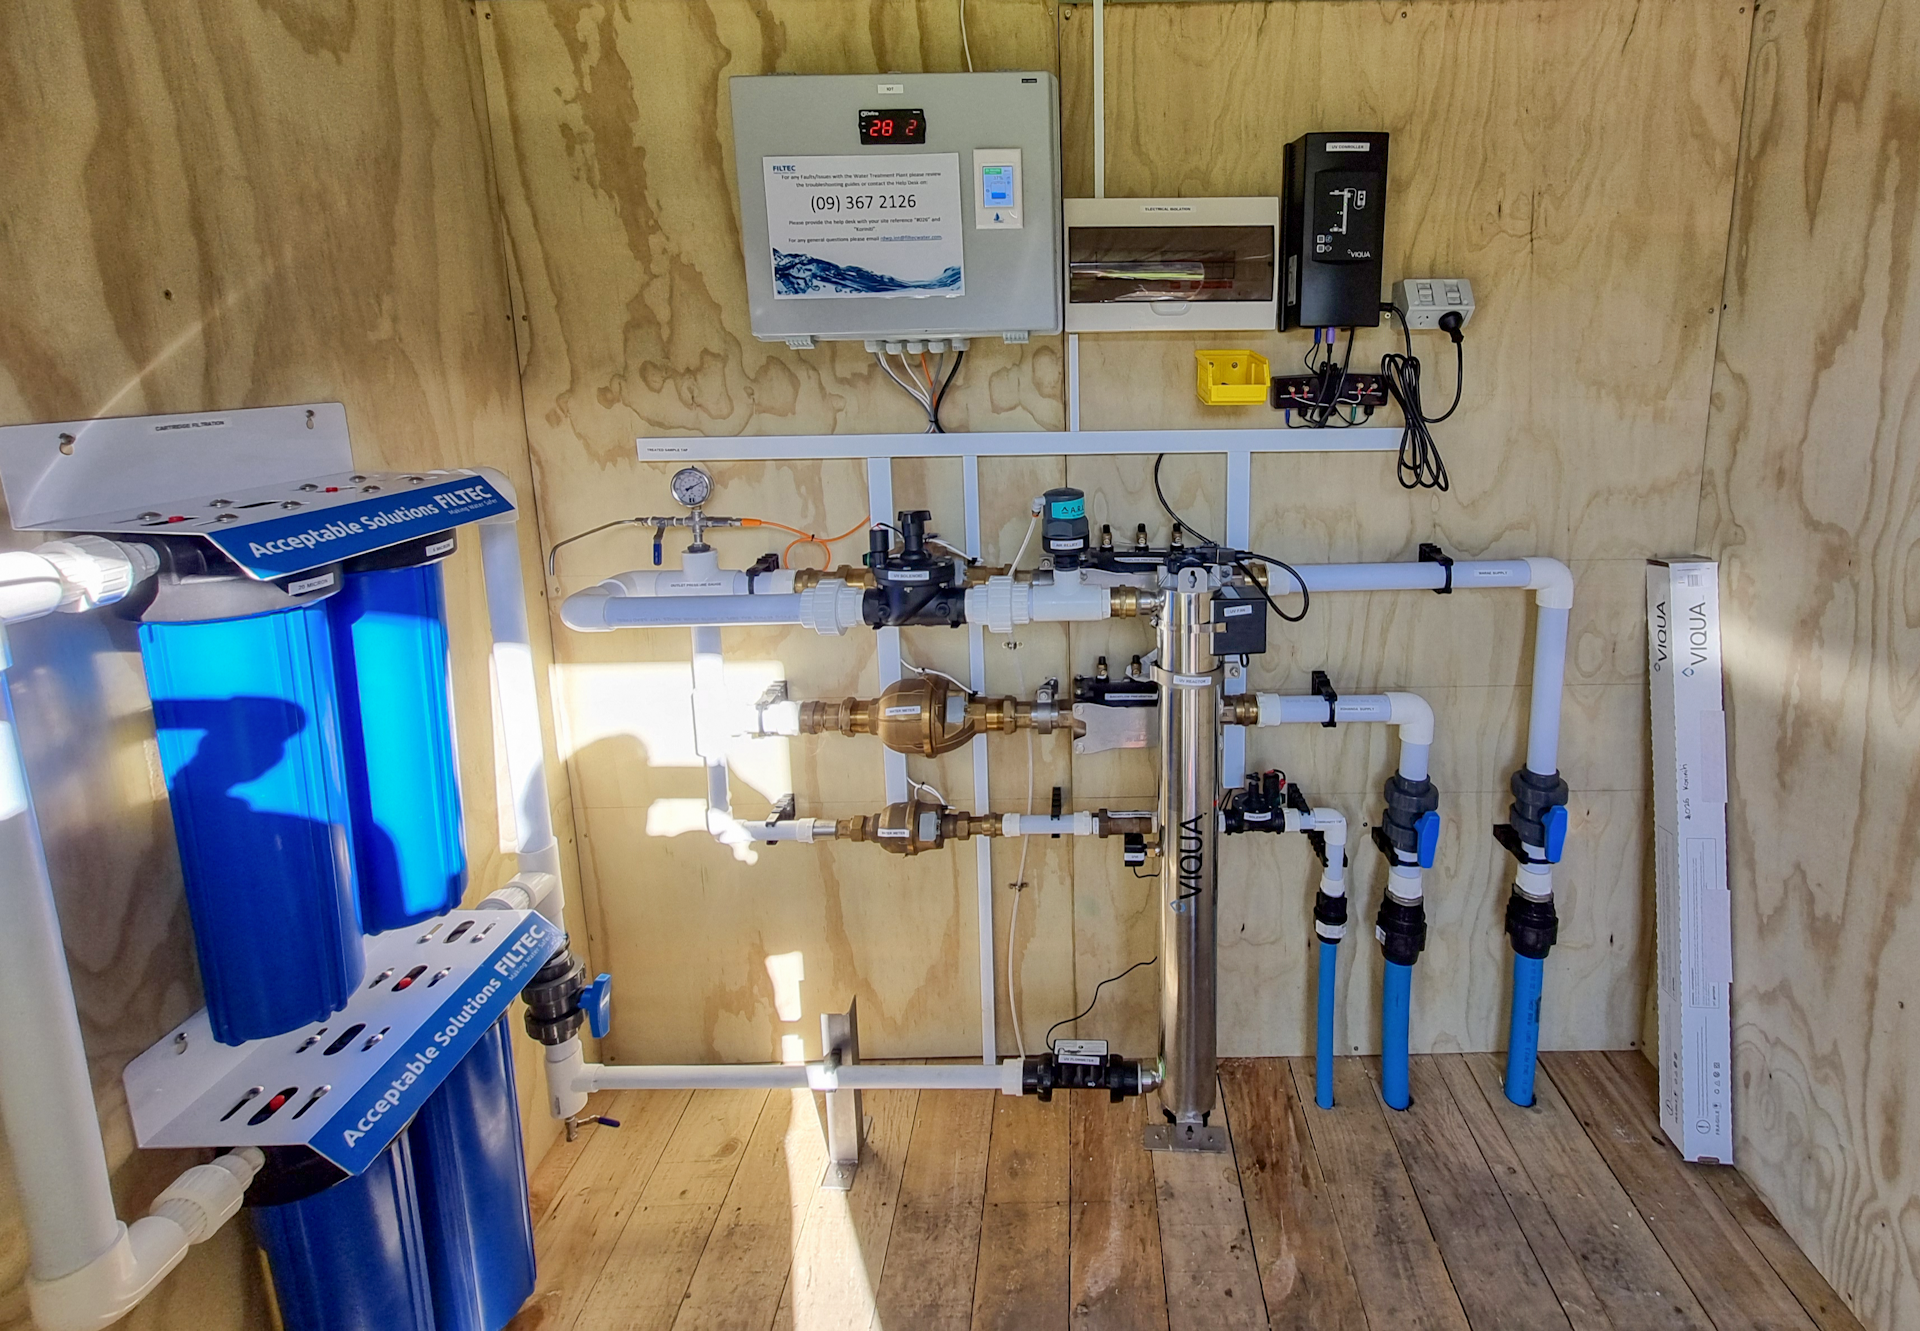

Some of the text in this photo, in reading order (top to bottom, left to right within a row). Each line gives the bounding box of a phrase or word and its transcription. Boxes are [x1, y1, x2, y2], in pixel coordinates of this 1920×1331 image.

[869, 119, 918, 136] 28 2
[811, 194, 916, 214] (09) 367 2126
[155, 423, 190, 431] CARTRIDGE
[432, 485, 492, 509] FILTEC
[448, 506, 470, 515] Making
[249, 503, 440, 558] Acceptable Solutions
[306, 579, 328, 589] MICRON
[1656, 601, 1668, 662] VIQUA
[1689, 601, 1708, 666] VIQUA
[1179, 814, 1203, 900] VIQUA
[494, 924, 546, 976] FILTEC
[508, 962, 528, 981] Making
[524, 947, 540, 962] Water
[343, 977, 501, 1148] Acceptable Solutions
